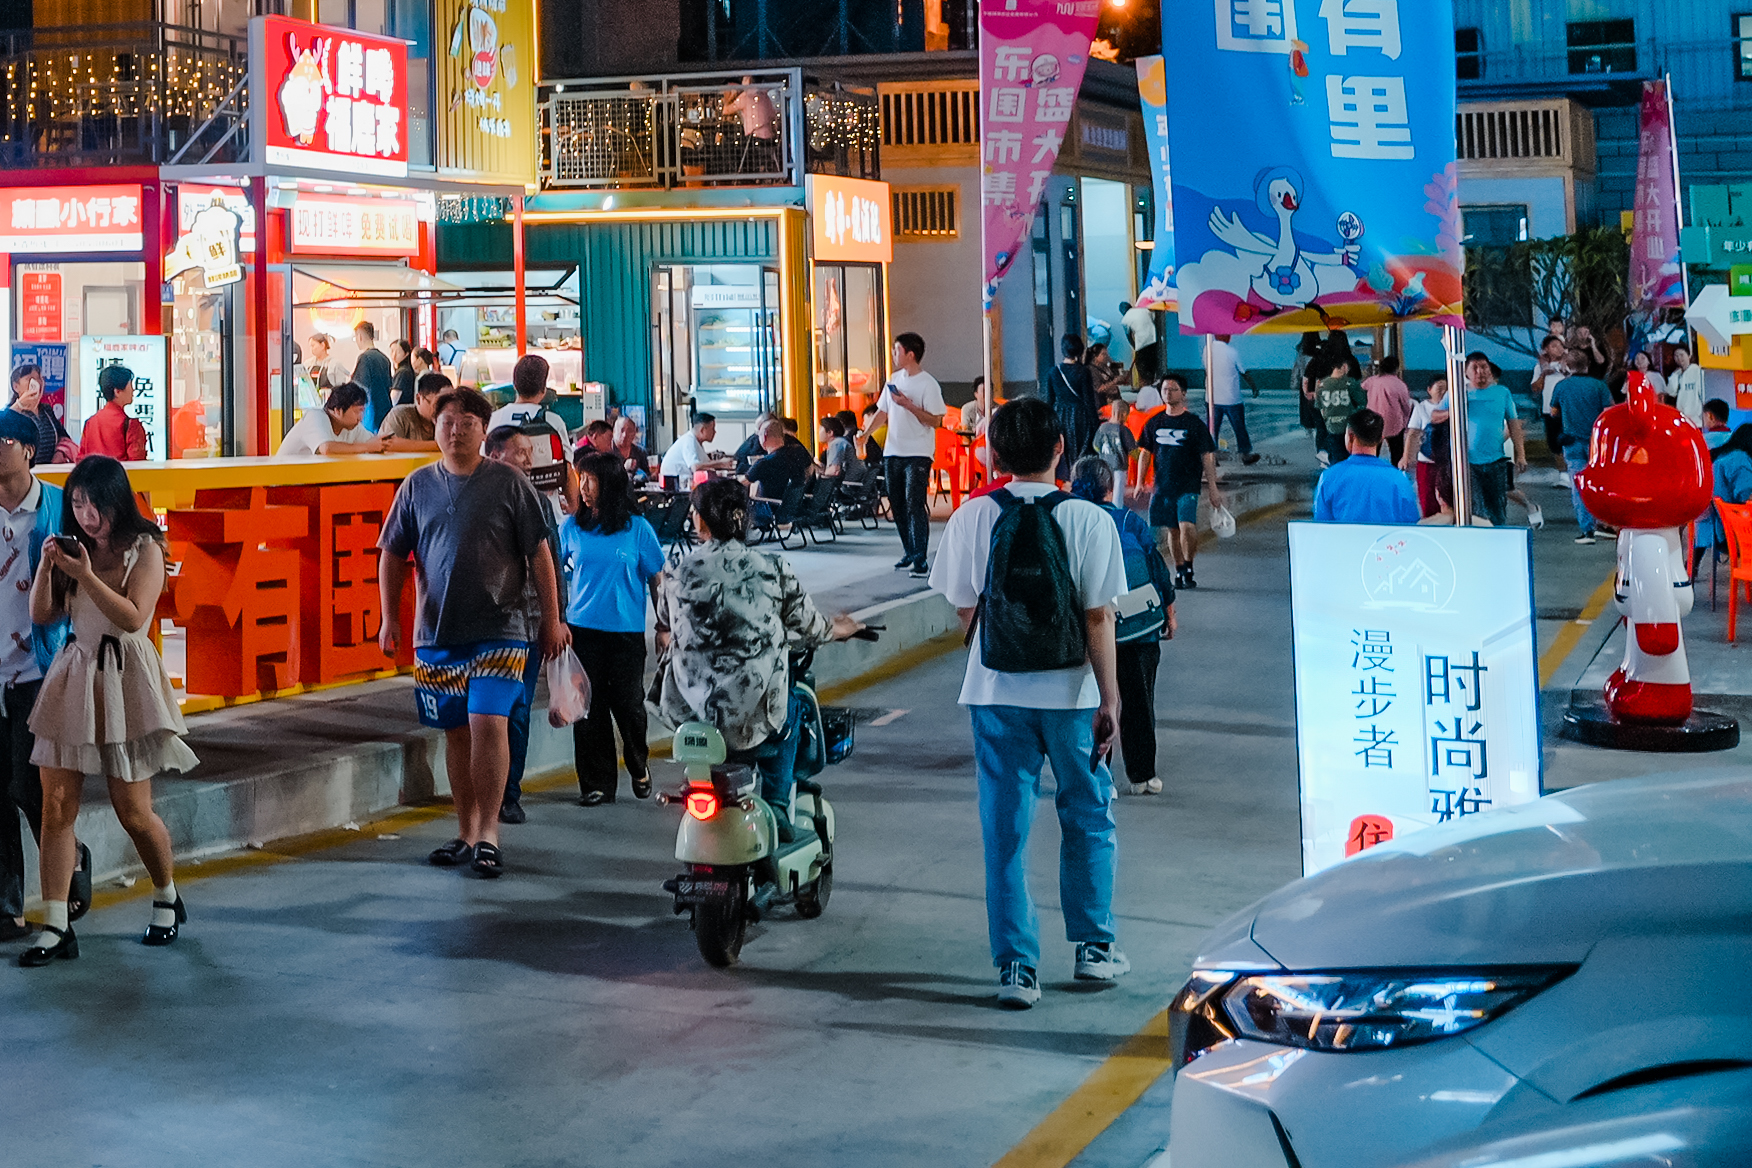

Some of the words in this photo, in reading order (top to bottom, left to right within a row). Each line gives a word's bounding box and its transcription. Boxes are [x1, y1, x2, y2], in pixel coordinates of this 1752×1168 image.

[1724, 240, 1752, 252] 年少
[1350, 627, 1399, 769] 漫步者
